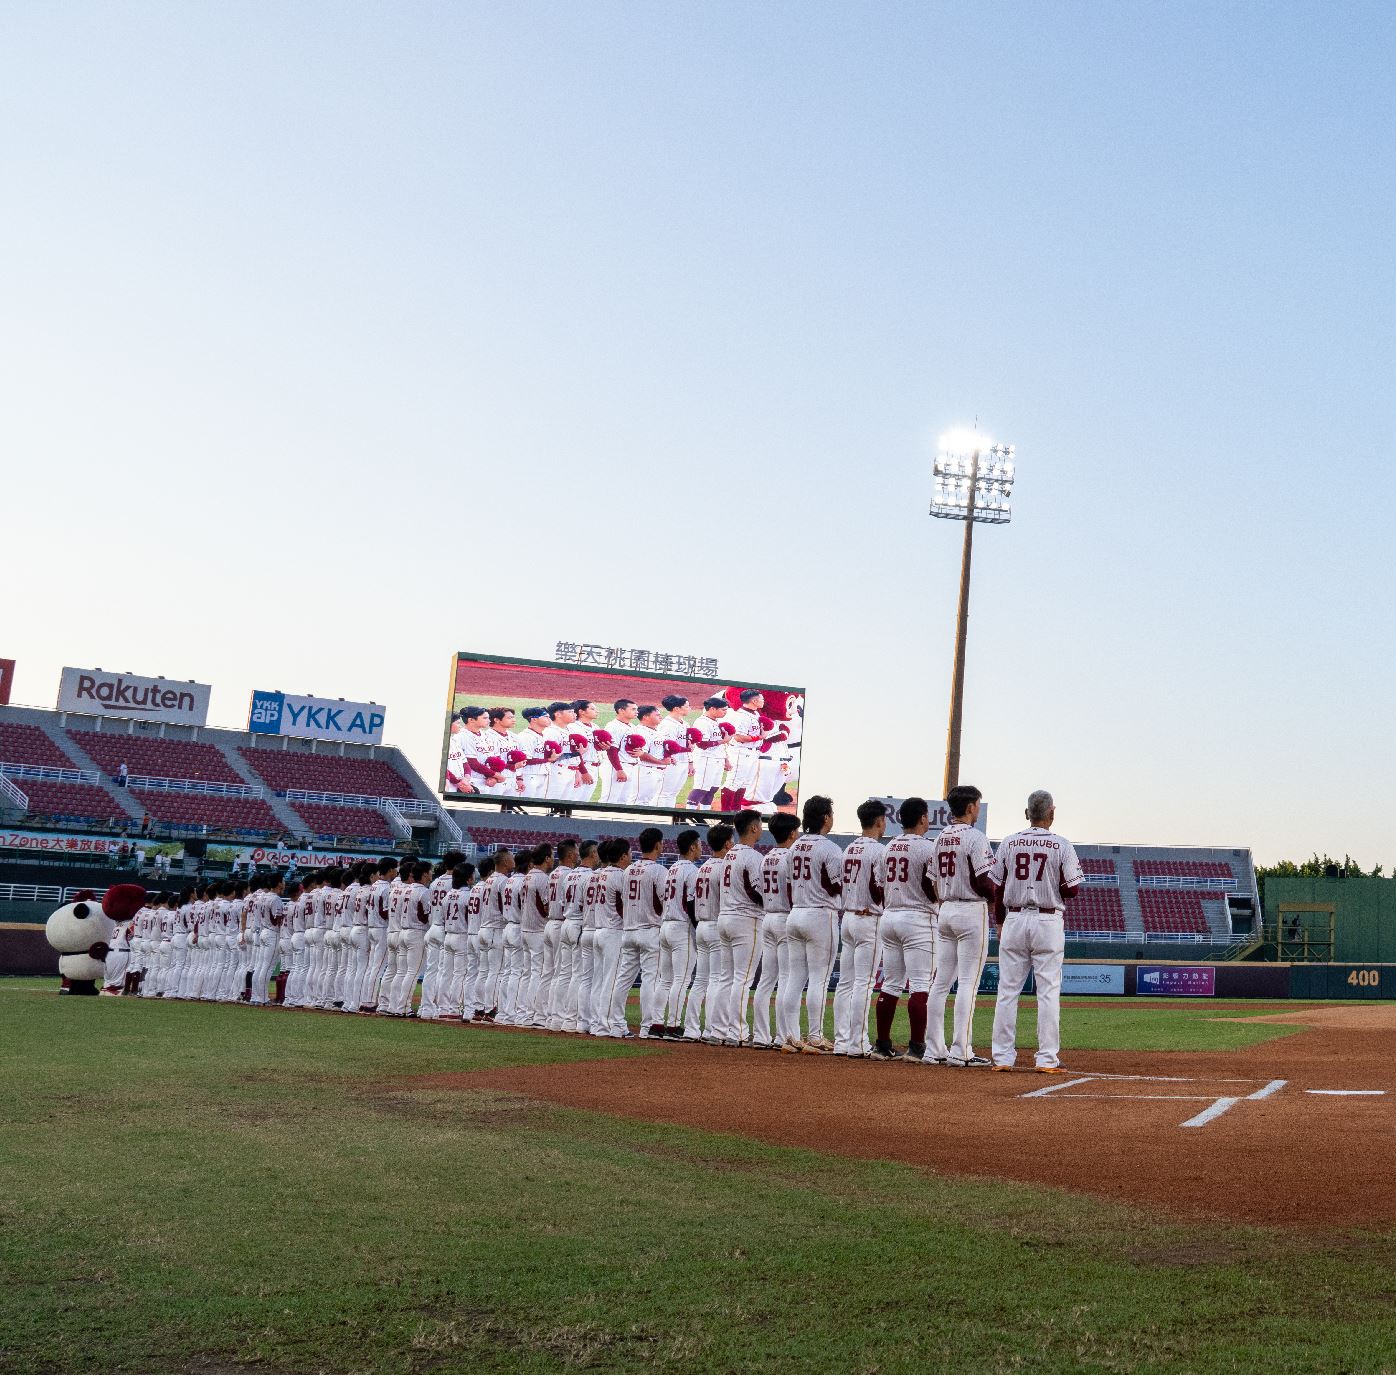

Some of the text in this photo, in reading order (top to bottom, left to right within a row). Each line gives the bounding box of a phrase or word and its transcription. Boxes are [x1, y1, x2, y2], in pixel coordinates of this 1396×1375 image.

[556, 641, 719, 678] 樂天桃園棒球場
[77, 675, 194, 712] Rakuten
[255, 700, 279, 710] YKK
[287, 703, 384, 734] YKK AP
[9, 834, 49, 848] Zone
[1009, 838, 1060, 849] FURUKUBO
[793, 856, 812, 880] 95
[843, 859, 862, 883] 97
[886, 857, 910, 882] 33
[938, 851, 958, 878] 66
[1015, 853, 1048, 881] 87
[629, 880, 642, 900] 91
[763, 870, 779, 894] 55
[1099, 974, 1112, 984] 35
[1348, 970, 1379, 986] 400
